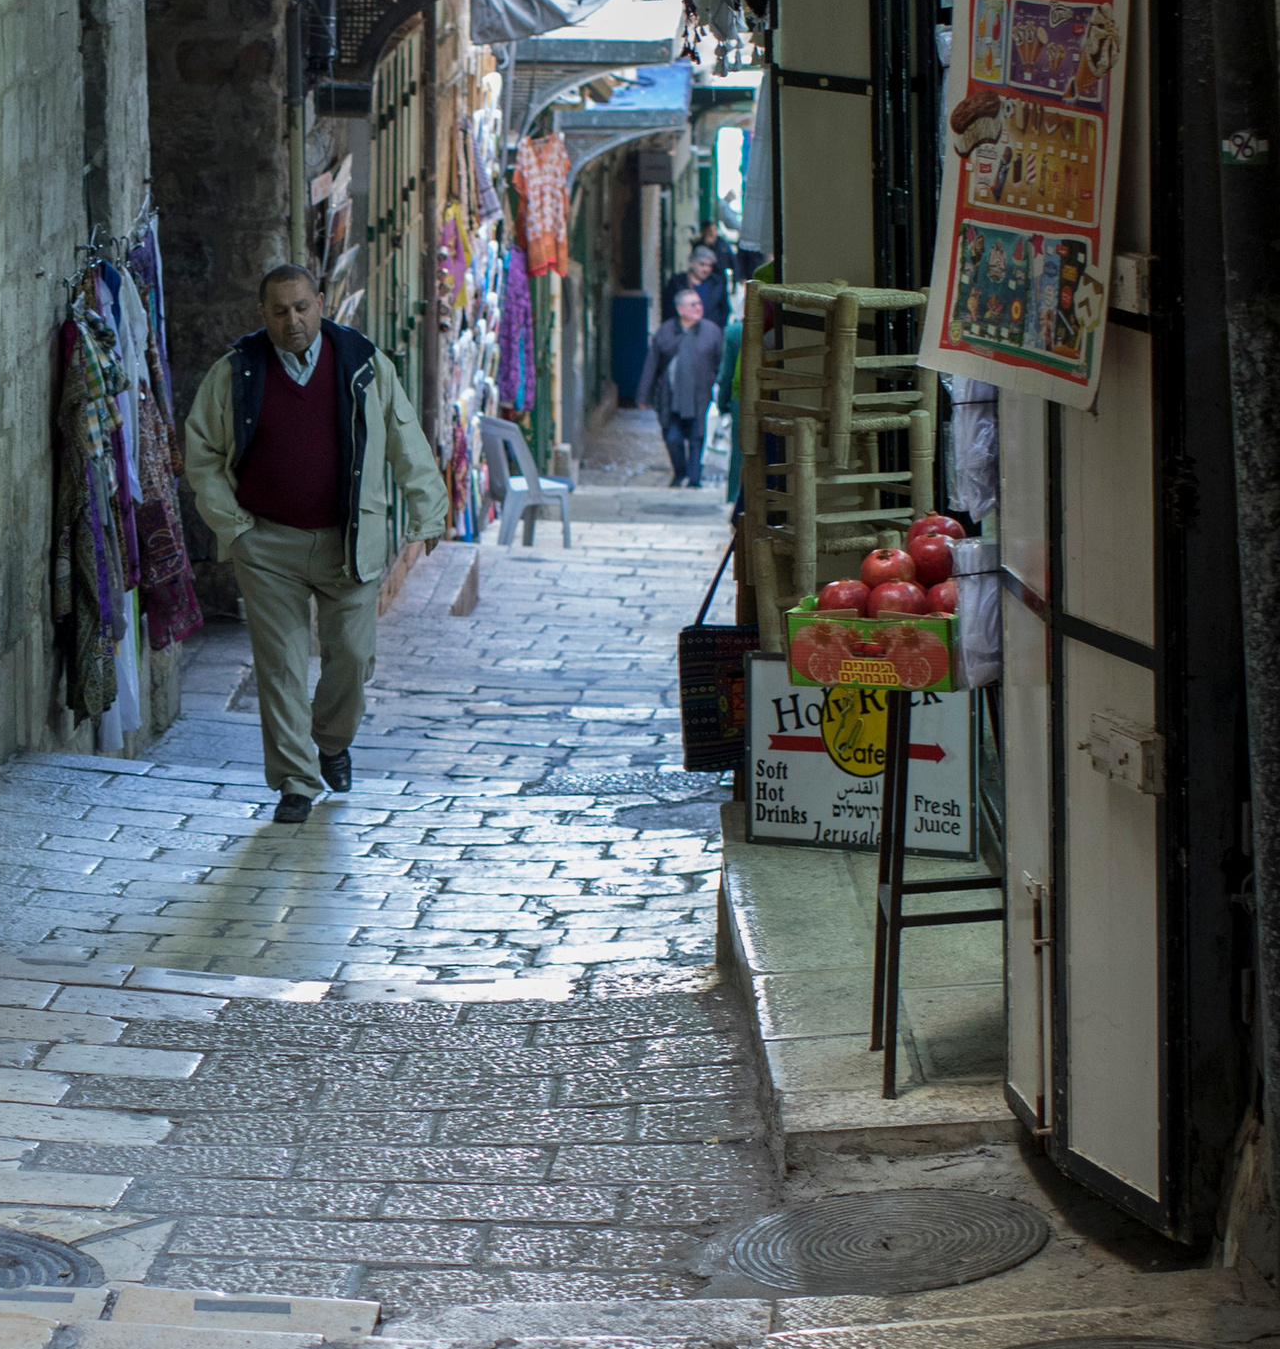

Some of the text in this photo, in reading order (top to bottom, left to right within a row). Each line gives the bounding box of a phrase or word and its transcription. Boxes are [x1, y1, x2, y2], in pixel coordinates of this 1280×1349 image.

[840, 672, 898, 685] מובחרים
[756, 759, 788, 780] Soft
[756, 782, 784, 802] Hot
[837, 779, 879, 801] القدس
[756, 803, 808, 824] Drinks
[914, 794, 961, 817] Fresh
[914, 816, 961, 835] Juice
